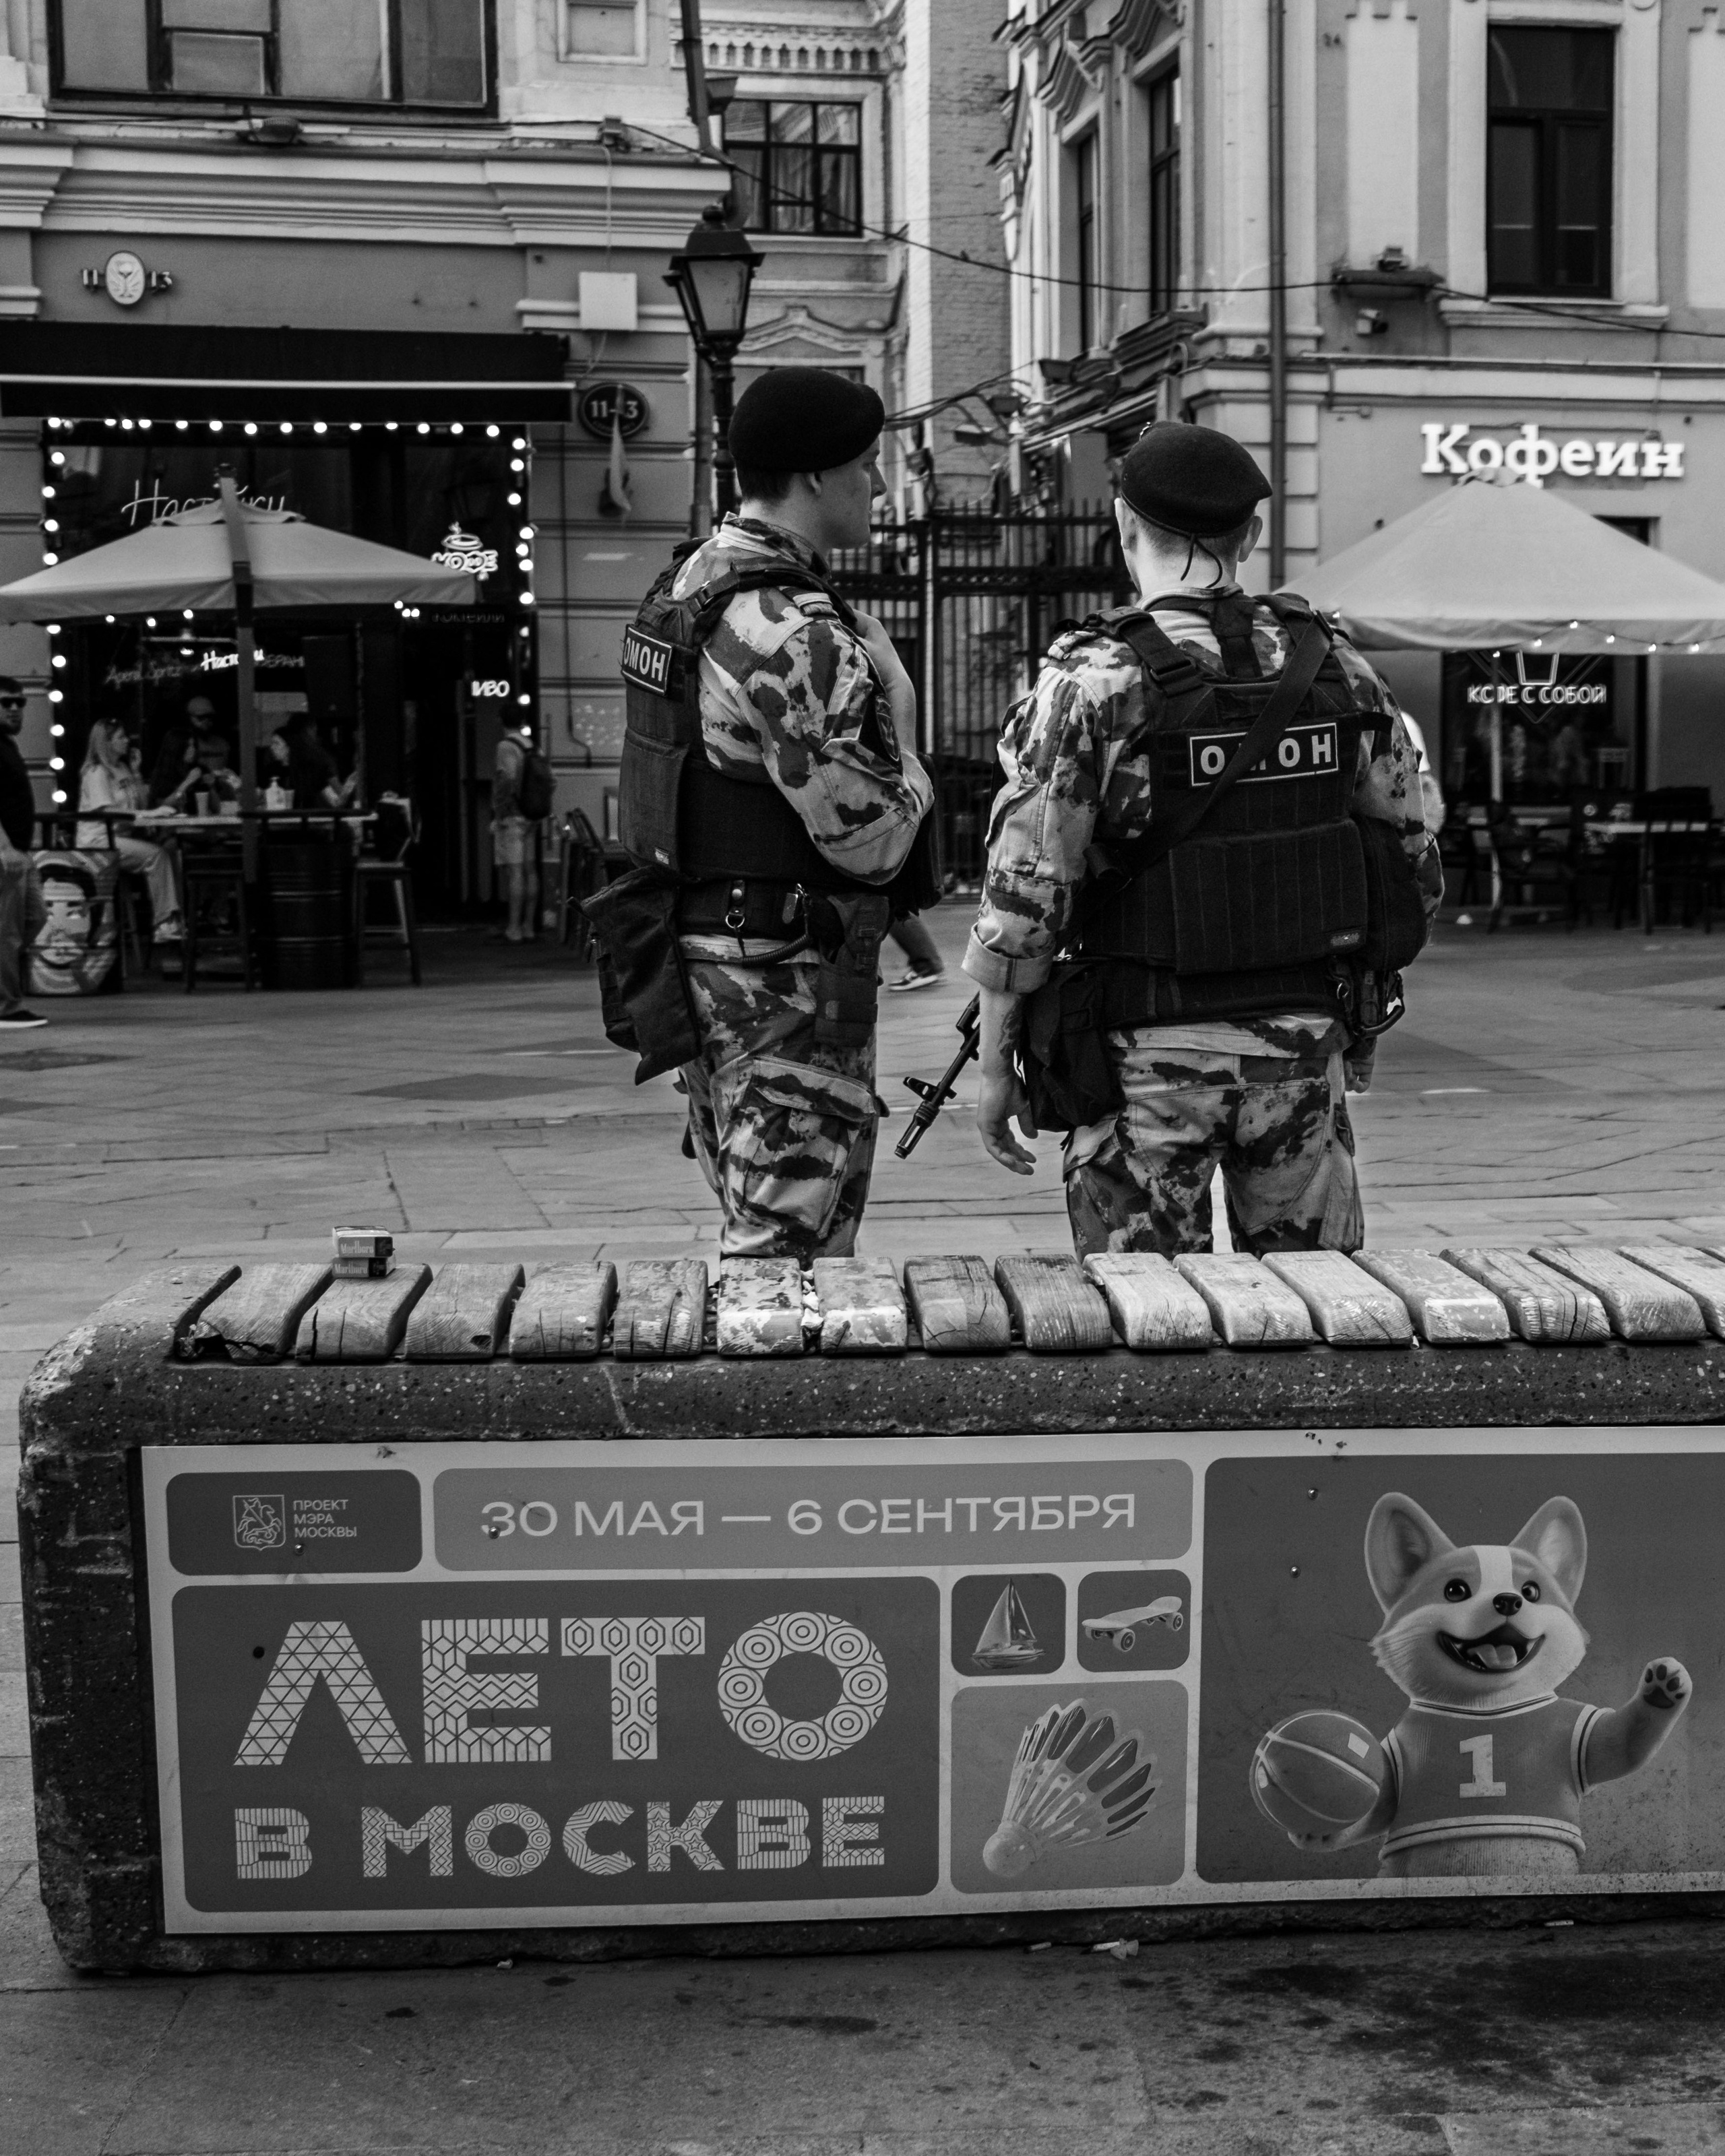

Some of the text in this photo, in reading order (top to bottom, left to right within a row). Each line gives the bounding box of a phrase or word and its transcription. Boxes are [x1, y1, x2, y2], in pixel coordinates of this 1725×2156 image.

[1421, 423, 1685, 489] Кофеин
[623, 634, 668, 683] ОМОН
[1199, 734, 1332, 775] ООН
[340, 1240, 374, 1254] Marlboro
[293, 1499, 349, 1511] ПРОЕКТ
[294, 1513, 334, 1525] МЭРА
[480, 1501, 559, 1536] 30
[574, 1500, 704, 1536] МАЯ
[787, 1499, 822, 1535] 6
[837, 1494, 1136, 1535] СЕНТЯБРЯ
[294, 1526, 357, 1538] МОСКВЫ
[232, 1611, 889, 1767] ЛЕТО
[1459, 1734, 1507, 1799] 1
[234, 1796, 885, 1880] В МОСКВЕ
